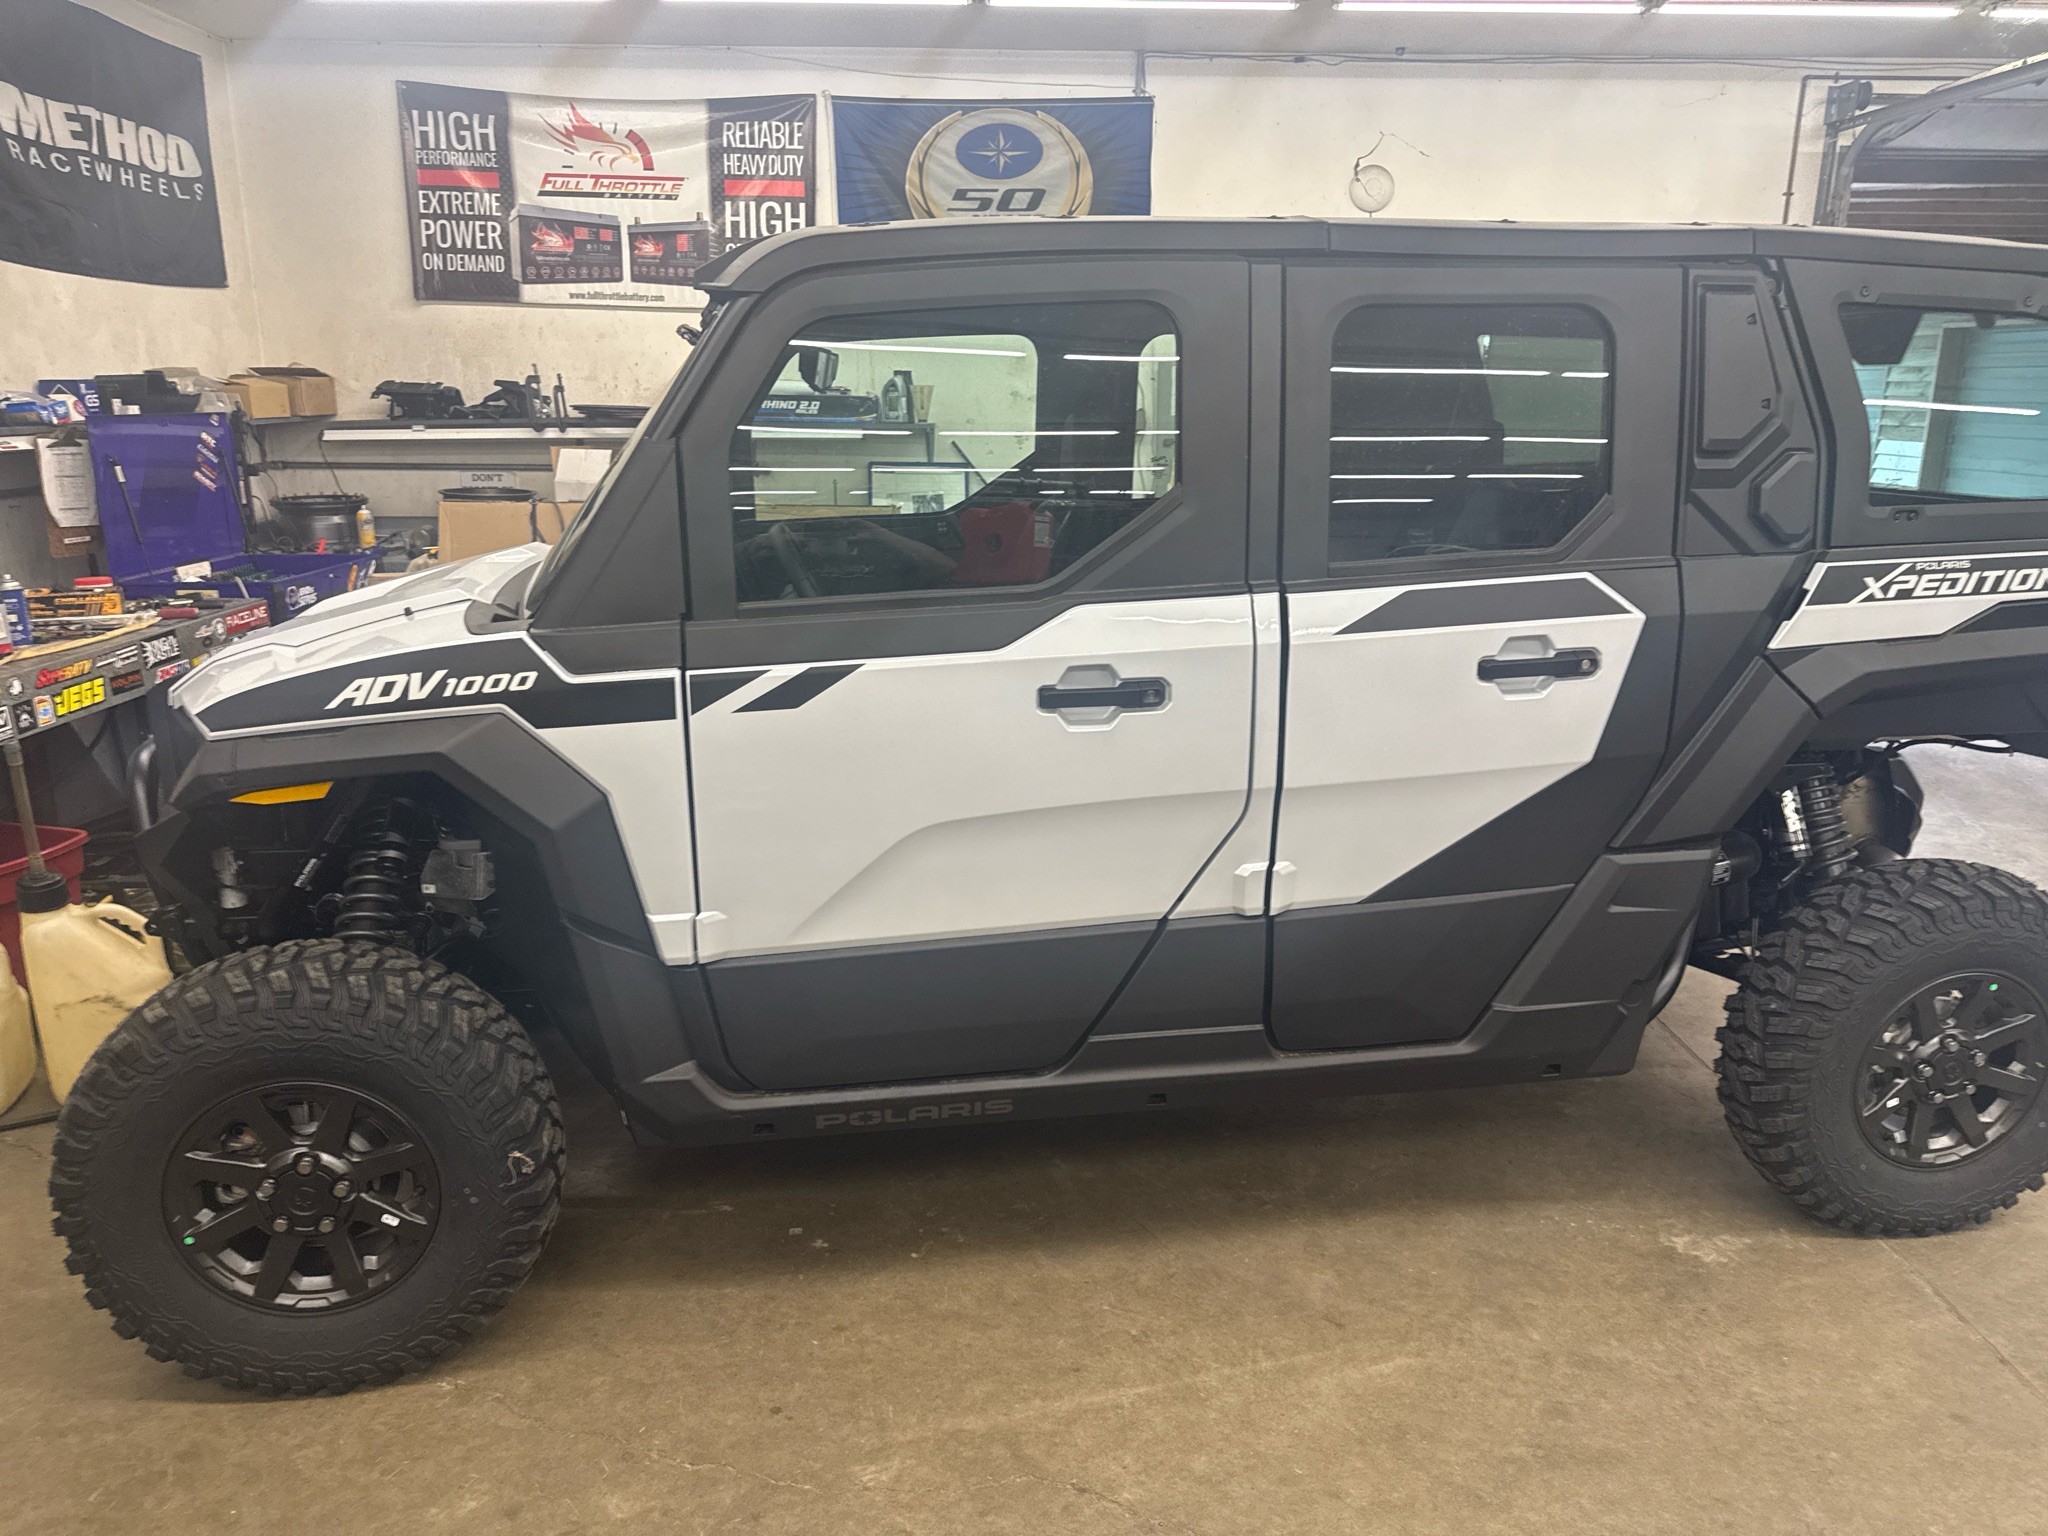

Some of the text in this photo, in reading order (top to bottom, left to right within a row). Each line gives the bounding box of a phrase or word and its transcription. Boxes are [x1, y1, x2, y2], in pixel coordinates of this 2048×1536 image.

[0, 81, 203, 178] METHOD
[412, 110, 497, 151] HIGH
[723, 121, 804, 149] RELIABLE
[415, 150, 499, 168] PERFORMANCE
[723, 153, 804, 176] HEAVY DUTY
[540, 173, 685, 193] FULL THROTTLE
[418, 191, 502, 216] EXTREME
[602, 192, 679, 200] BATTERY
[946, 188, 1047, 213] 50
[725, 201, 806, 239] HIGH
[420, 219, 504, 250] POWER
[422, 253, 505, 273] ON DEMAND
[1915, 560, 1972, 572] POLARIS
[224, 606, 268, 627] RACELINE
[53, 677, 105, 716] JEGS
[323, 669, 539, 710] ADV 1000
[815, 1099, 1015, 1130] POLARIS
